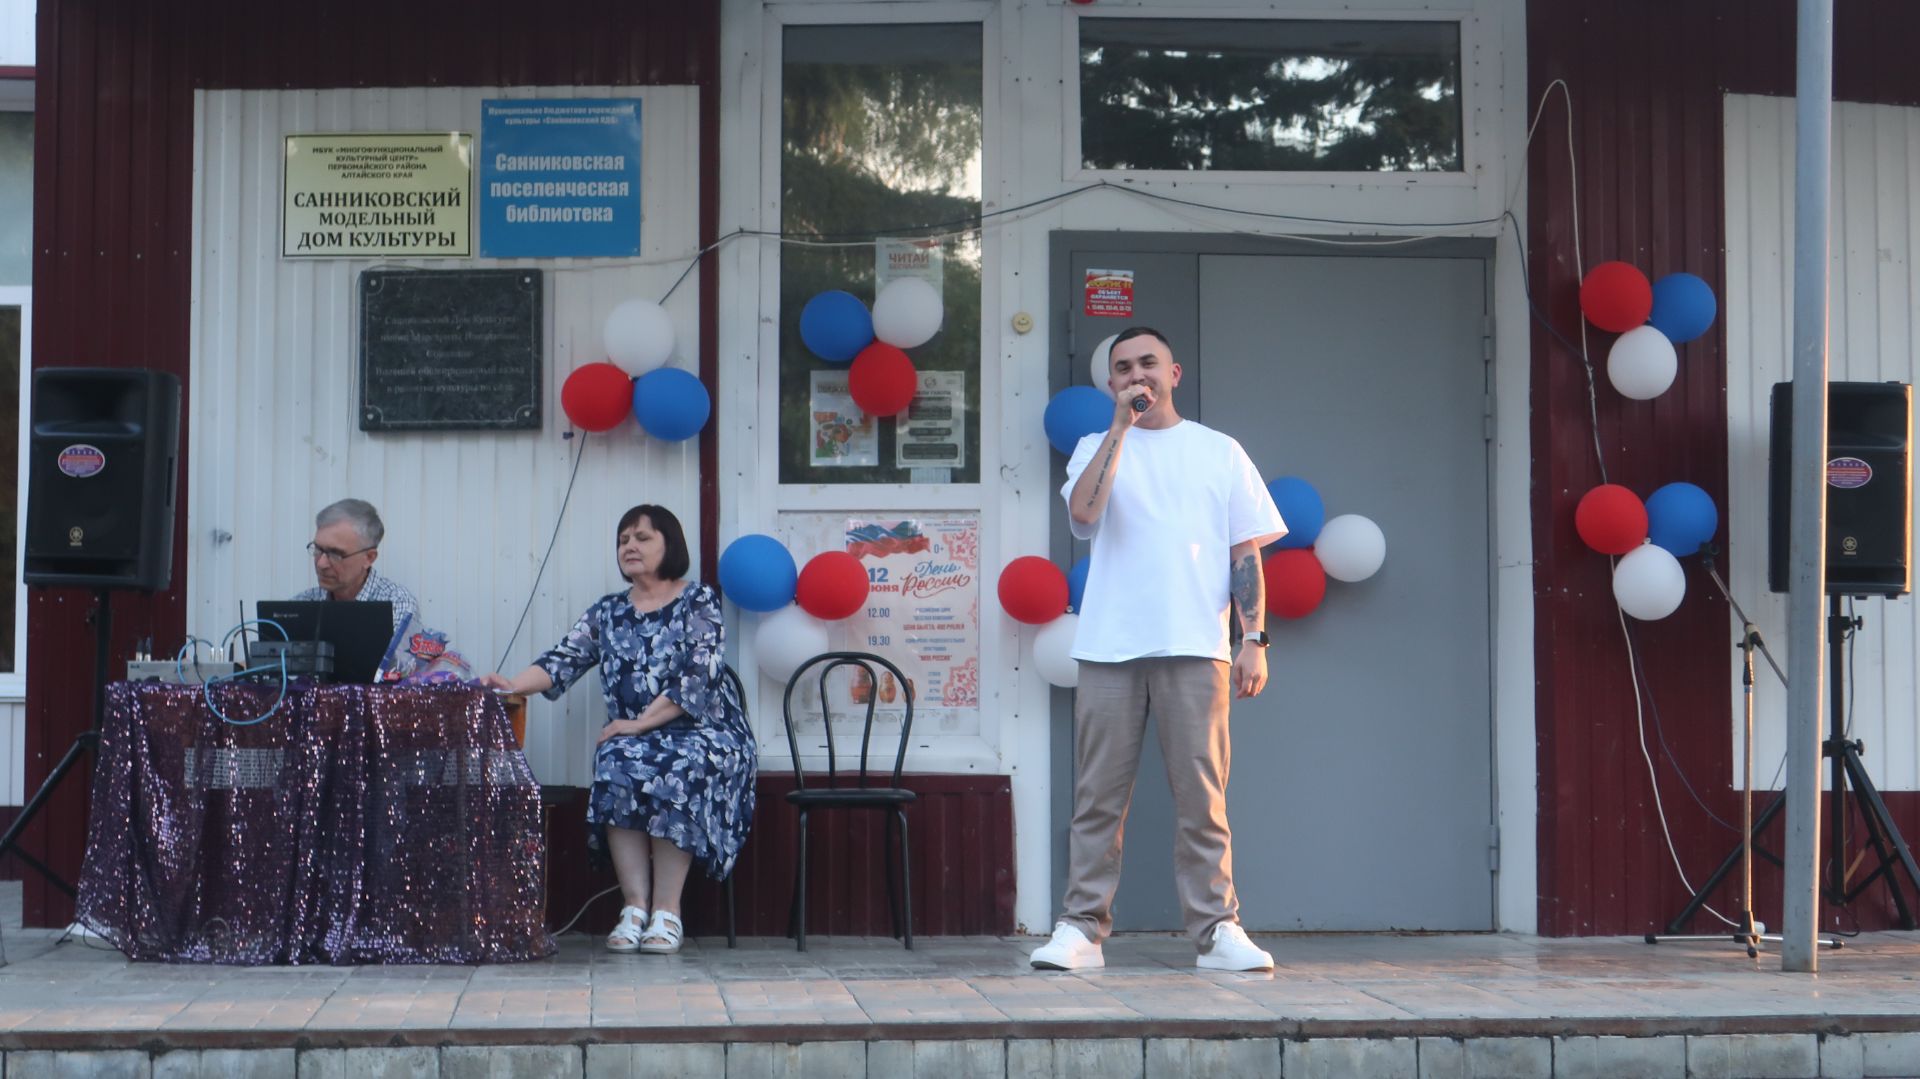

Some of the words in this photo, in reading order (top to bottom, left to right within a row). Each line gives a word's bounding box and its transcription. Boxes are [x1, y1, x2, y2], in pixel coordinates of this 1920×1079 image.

[335, 145, 443, 154] «МНОГОФУНКЦИОНАЛЬНЫЙ
[335, 154, 388, 162] КУЛЬТУРНЫЙ
[495, 153, 625, 172] Санниковская
[327, 162, 394, 171] ПЕРВОМАЙСКОГО
[395, 162, 427, 171] РАЙОНА
[341, 171, 392, 179] АЛТАЙСКОГО
[490, 180, 629, 197] поселенческая
[293, 187, 462, 209] САННИКОВСКИЙ
[318, 208, 436, 228] МОДЕЛЬНЫЙ
[506, 203, 614, 223] библиотека
[297, 232, 344, 251] ДОМ
[349, 231, 456, 249] КУЛЬТУРЫ
[888, 251, 930, 263] ЧИТАЙ
[933, 544, 944, 554] 0+
[868, 567, 889, 583] 12
[915, 560, 961, 578] День
[900, 573, 971, 598] России
[867, 607, 890, 618] 12.00
[867, 635, 890, 646] 19.30
